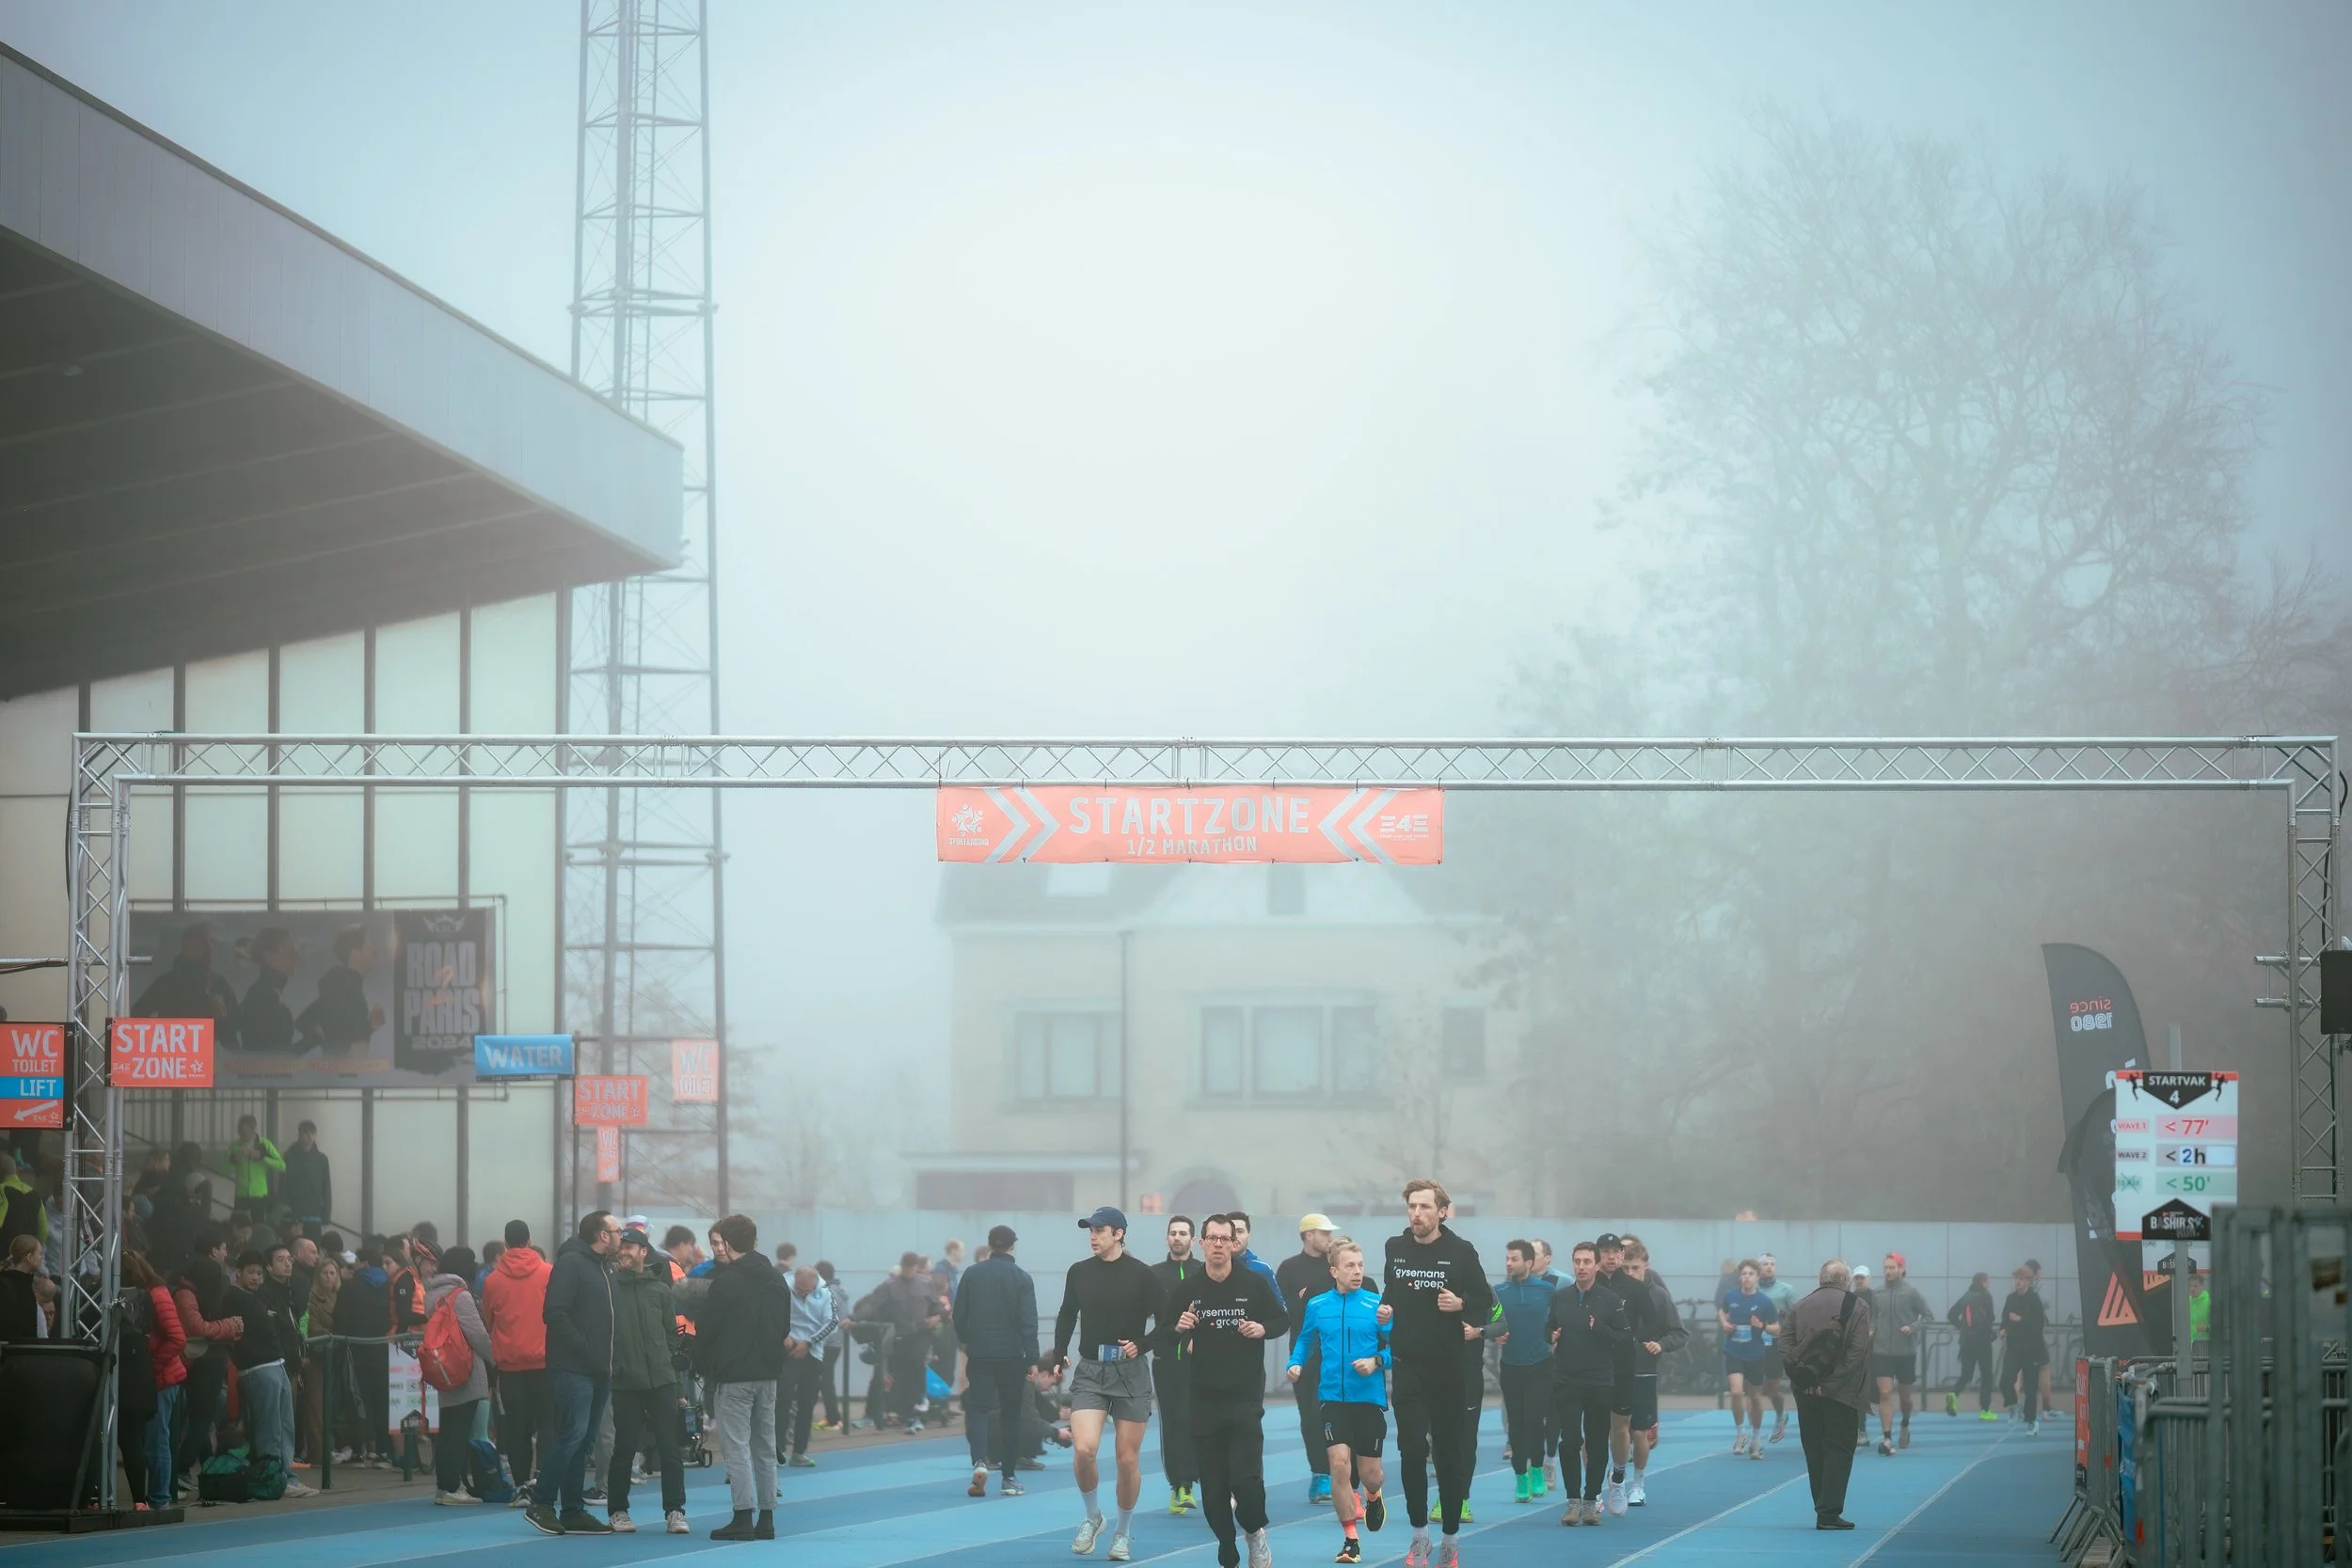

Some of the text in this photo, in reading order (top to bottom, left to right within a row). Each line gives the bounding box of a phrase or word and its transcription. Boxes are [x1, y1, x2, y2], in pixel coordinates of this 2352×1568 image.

[1069, 795, 1310, 834] STARTZONE
[1127, 835, 1257, 857] 1/2 MARATHON
[406, 941, 477, 988] ROAD
[404, 988, 480, 1036] PARIS
[11, 1029, 58, 1057] WC
[117, 1023, 204, 1053] START
[411, 1036, 472, 1051] 2024
[11, 1059, 56, 1073] TOILET
[485, 1045, 564, 1069] WATER
[676, 1043, 714, 1075] WC
[132, 1056, 187, 1079] ZONE
[20, 1079, 56, 1097] LIFT
[677, 1077, 714, 1095] TOILET
[2148, 1075, 2206, 1086] STARTVAK
[579, 1080, 641, 1101] START
[2169, 1090, 2180, 1103] 4
[588, 1102, 628, 1120] ZONE
[2118, 1121, 2140, 1130] WAVE
[2118, 1151, 2147, 1160] WAVE 2
[1216, 1318, 1240, 1329] groe
